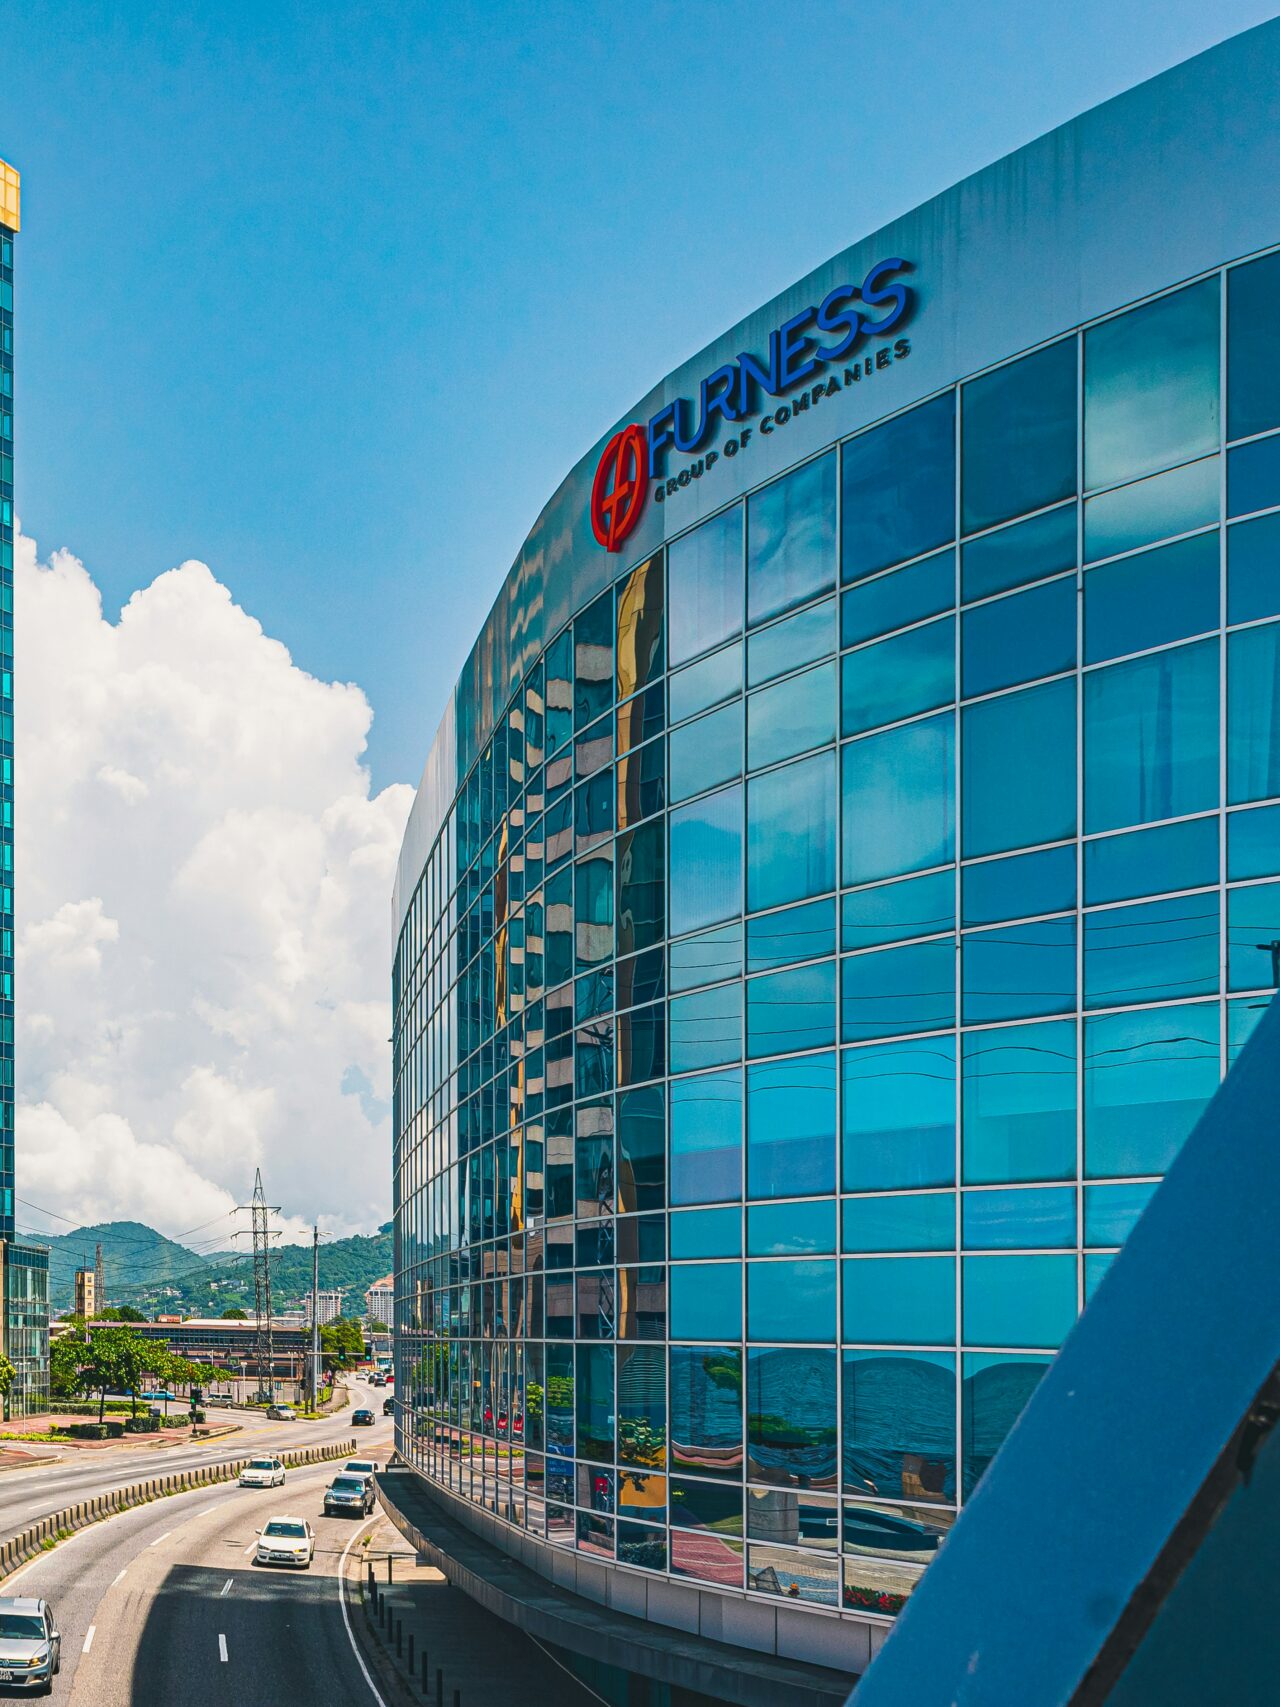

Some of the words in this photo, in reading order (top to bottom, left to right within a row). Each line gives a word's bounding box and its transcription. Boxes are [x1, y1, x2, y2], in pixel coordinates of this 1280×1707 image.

[648, 257, 911, 480] FURNESS
[654, 451, 719, 503] GROUP
[723, 428, 753, 458] OF
[759, 338, 912, 435] COMPANIES
